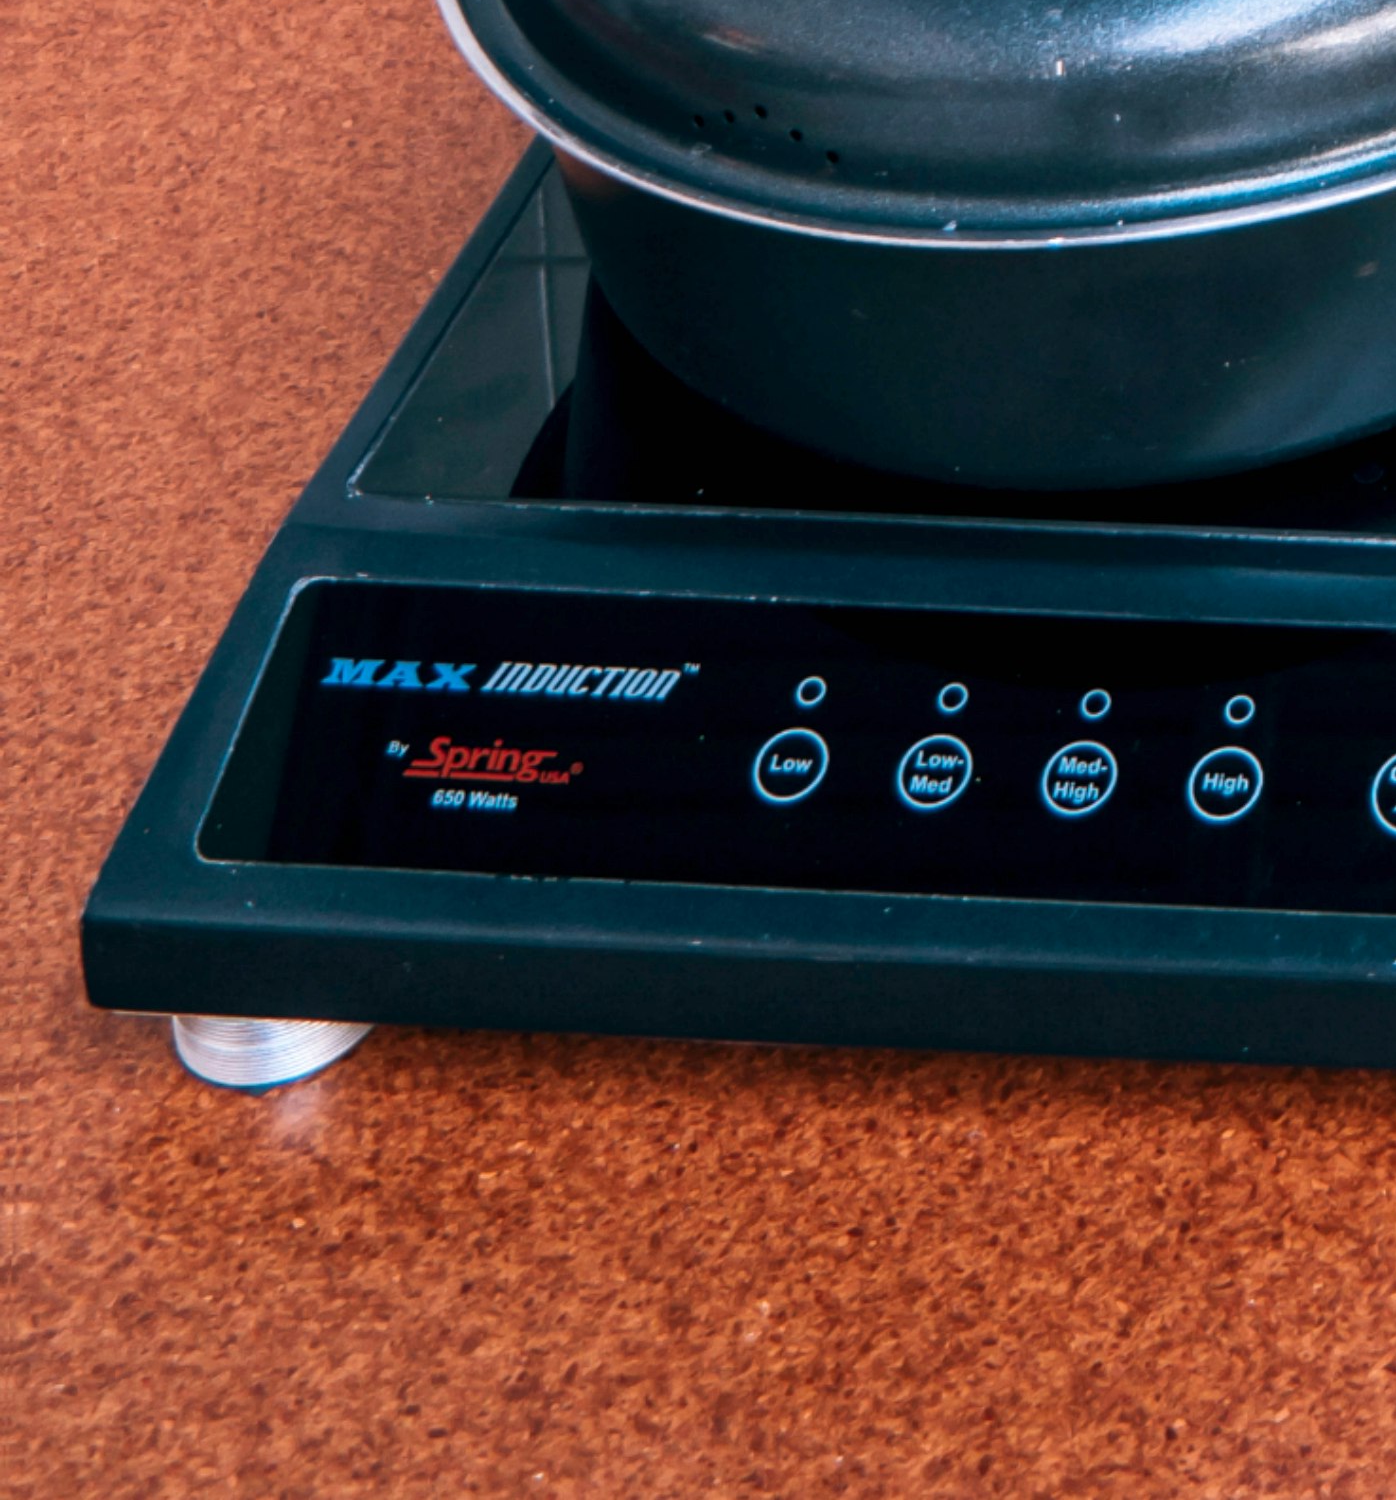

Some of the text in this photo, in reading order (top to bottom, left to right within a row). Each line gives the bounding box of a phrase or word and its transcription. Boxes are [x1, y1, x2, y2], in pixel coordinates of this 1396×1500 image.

[320, 656, 477, 692] MAX
[385, 739, 410, 759] By
[408, 735, 559, 784] Spring
[769, 753, 814, 774] Low
[914, 750, 965, 771] Low-
[1056, 756, 1108, 776] Med-
[909, 775, 953, 795] Med
[1052, 780, 1100, 805] High
[1201, 771, 1250, 796] High
[430, 788, 519, 811] 650 Watts
